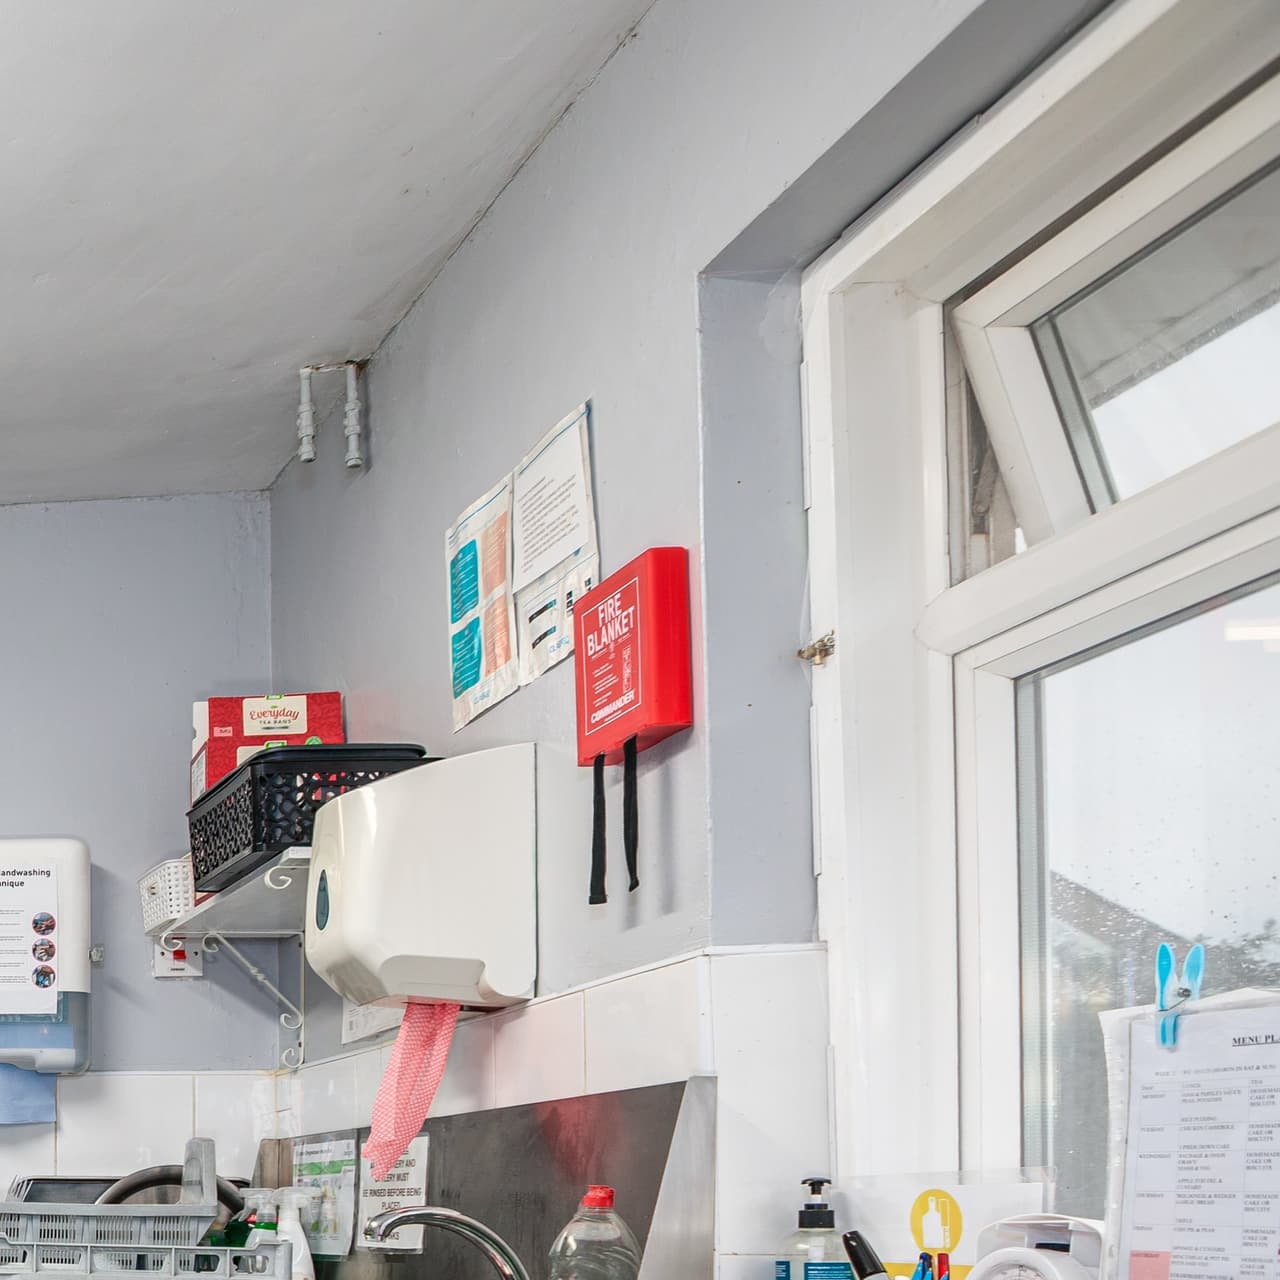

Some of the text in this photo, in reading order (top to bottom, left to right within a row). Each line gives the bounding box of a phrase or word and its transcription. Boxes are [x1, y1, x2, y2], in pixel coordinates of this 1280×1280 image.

[598, 592, 622, 627] FIRE
[587, 606, 635, 657] BLANKET
[591, 689, 635, 724] COMMANDER
[249, 708, 300, 720] Everyday
[1232, 1036, 1260, 1045] MENU
[405, 1159, 416, 1168] AND
[396, 1173, 410, 1181] MUST
[369, 1189, 386, 1197] RINSED
[387, 1188, 406, 1197] BEFORE
[407, 1187, 422, 1196] BEING
